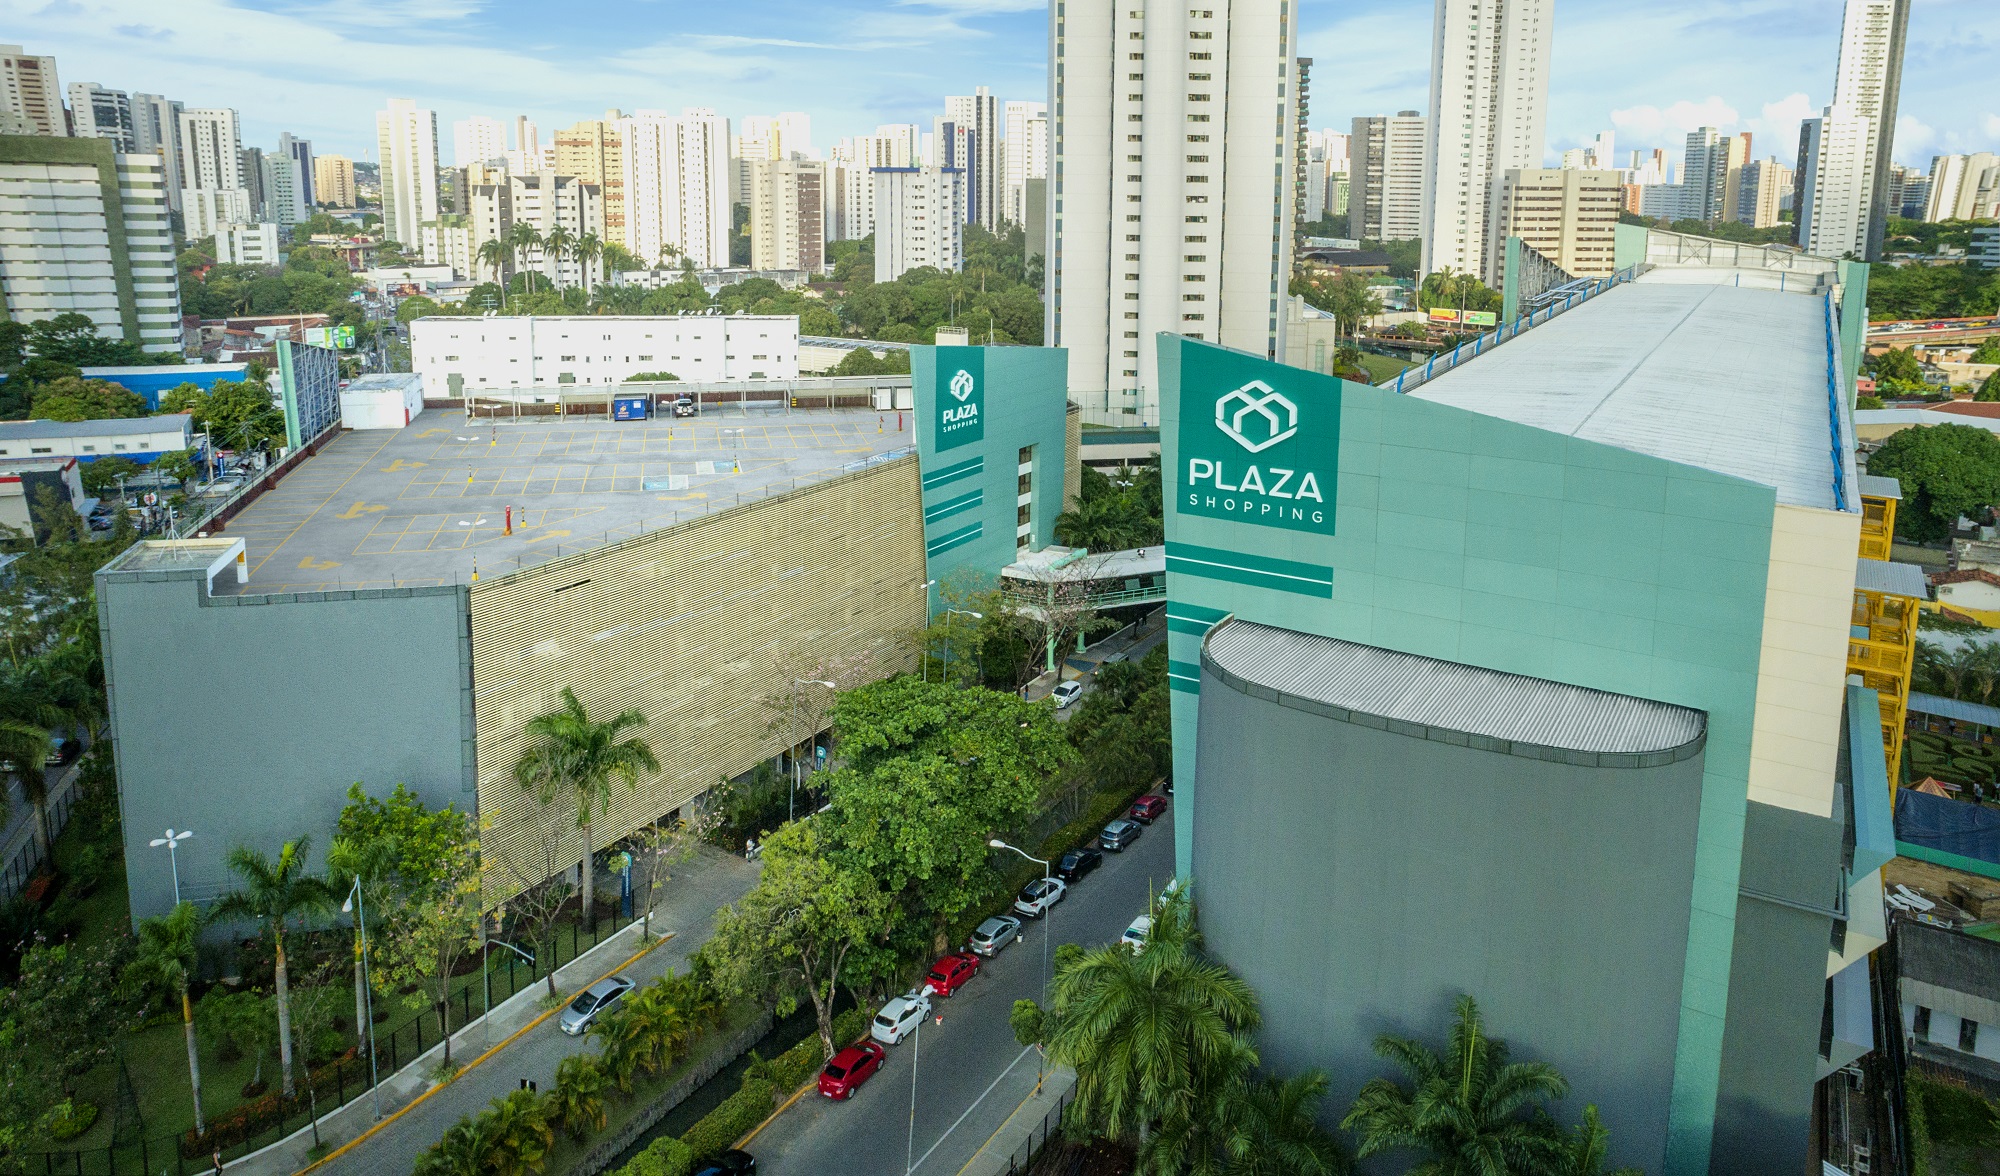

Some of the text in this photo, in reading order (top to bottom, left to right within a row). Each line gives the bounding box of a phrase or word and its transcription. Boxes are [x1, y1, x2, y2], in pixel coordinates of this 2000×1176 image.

[943, 403, 978, 424] PLAZA
[943, 418, 978, 433] SHOPPING
[1189, 458, 1323, 503] PLAZA
[1189, 494, 1323, 523] SHOPPING
